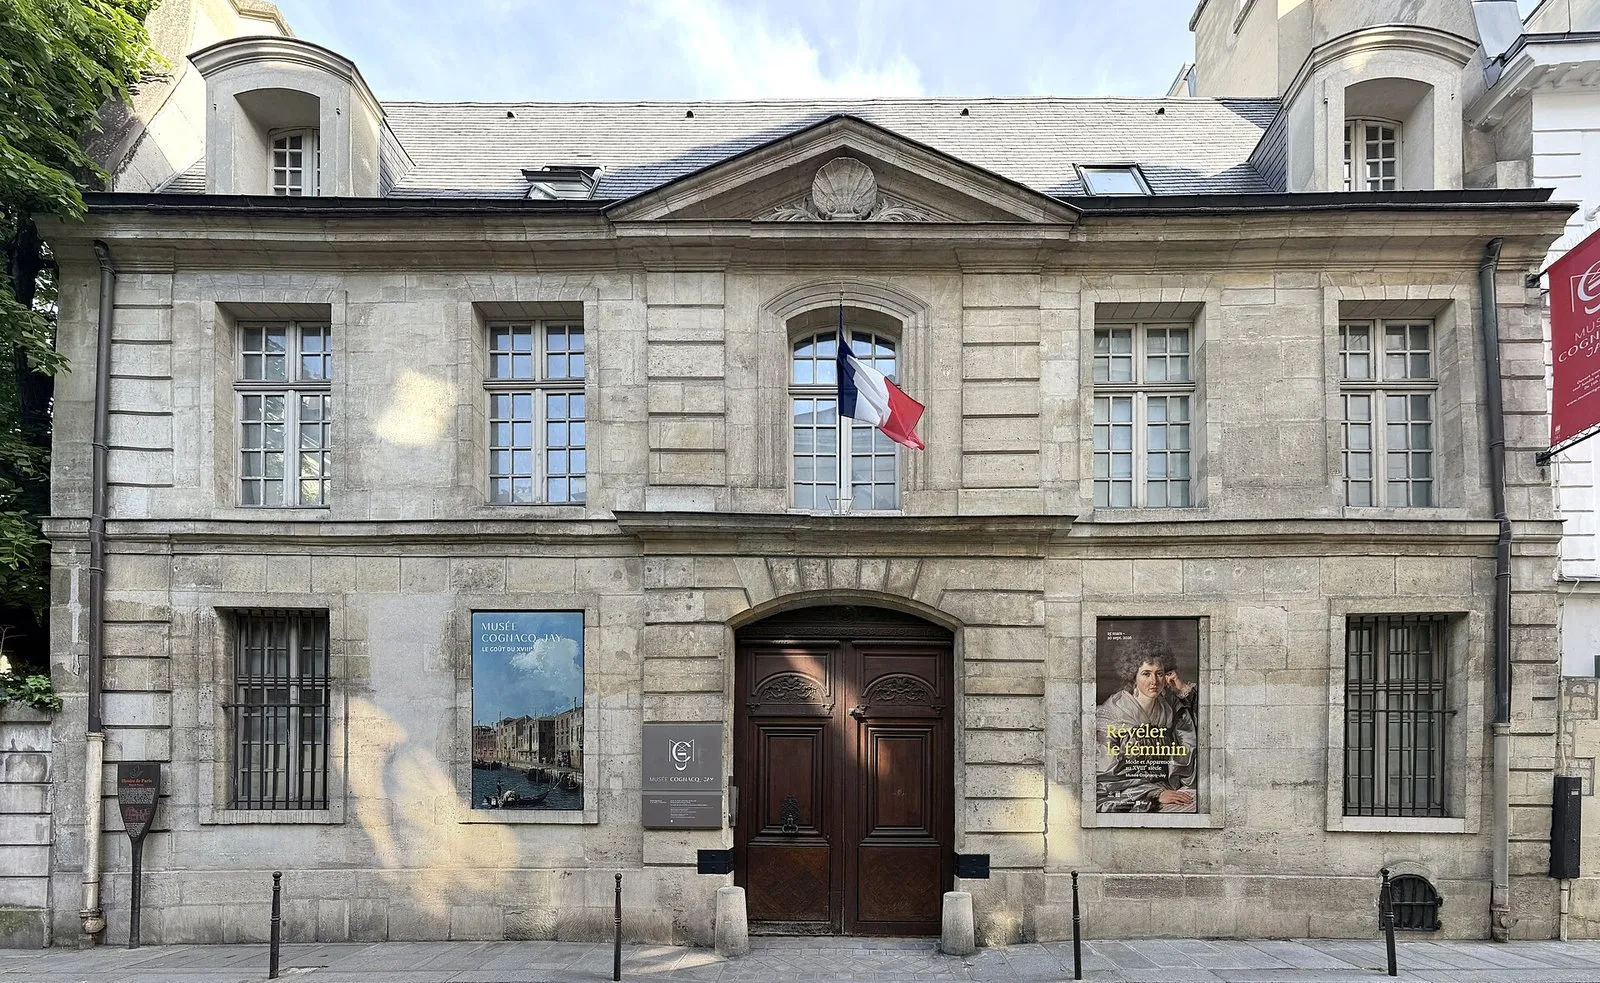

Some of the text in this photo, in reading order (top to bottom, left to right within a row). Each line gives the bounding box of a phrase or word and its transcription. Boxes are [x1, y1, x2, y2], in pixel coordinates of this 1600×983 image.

[481, 621, 517, 631] MUSÉE
[541, 633, 561, 643] JAY
[1106, 723, 1167, 738] Révéler
[1106, 741, 1187, 756] le féminin
